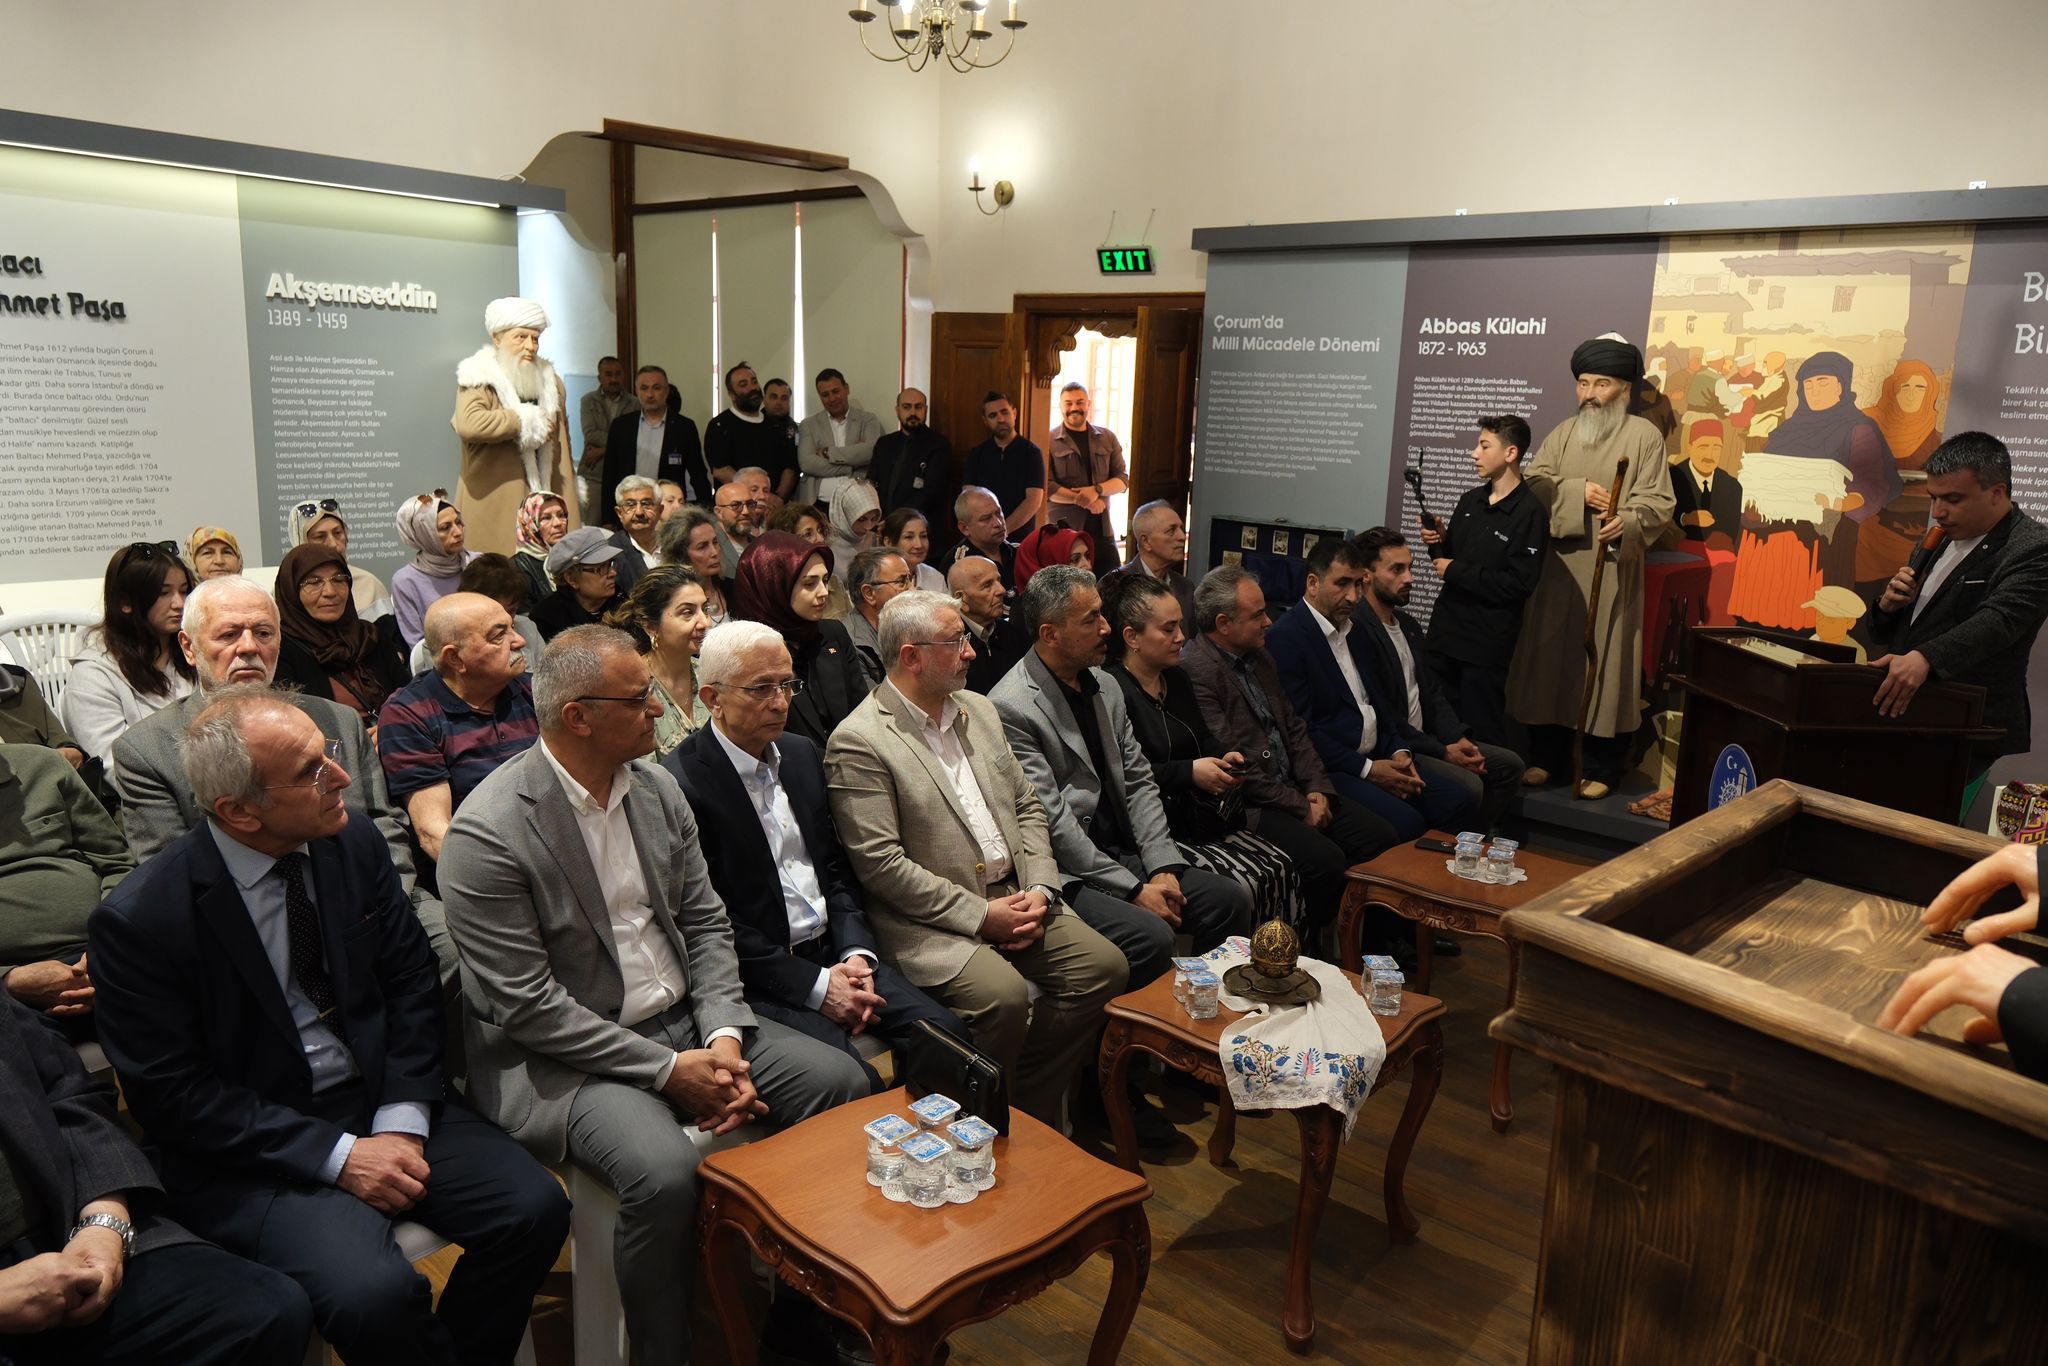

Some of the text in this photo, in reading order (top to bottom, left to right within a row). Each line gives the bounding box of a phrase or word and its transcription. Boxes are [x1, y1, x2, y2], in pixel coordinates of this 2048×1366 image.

[0, 254, 42, 274] acı
[1101, 251, 1146, 270] EXIT
[266, 272, 437, 309] Akşemseddin
[2024, 272, 2048, 302] B
[67, 292, 126, 322] Paşa
[268, 310, 301, 326] 1389
[317, 312, 348, 329] 1459
[1214, 314, 1284, 332] Çorum'da
[1419, 318, 1547, 335] Abbas Külahi
[1212, 336, 1380, 352] Milli Mücadele Dönemi
[1418, 341, 1445, 355] 1872
[1457, 341, 1486, 356] 1963
[2015, 324, 2048, 354] Bi
[2024, 399, 2038, 407] kat
